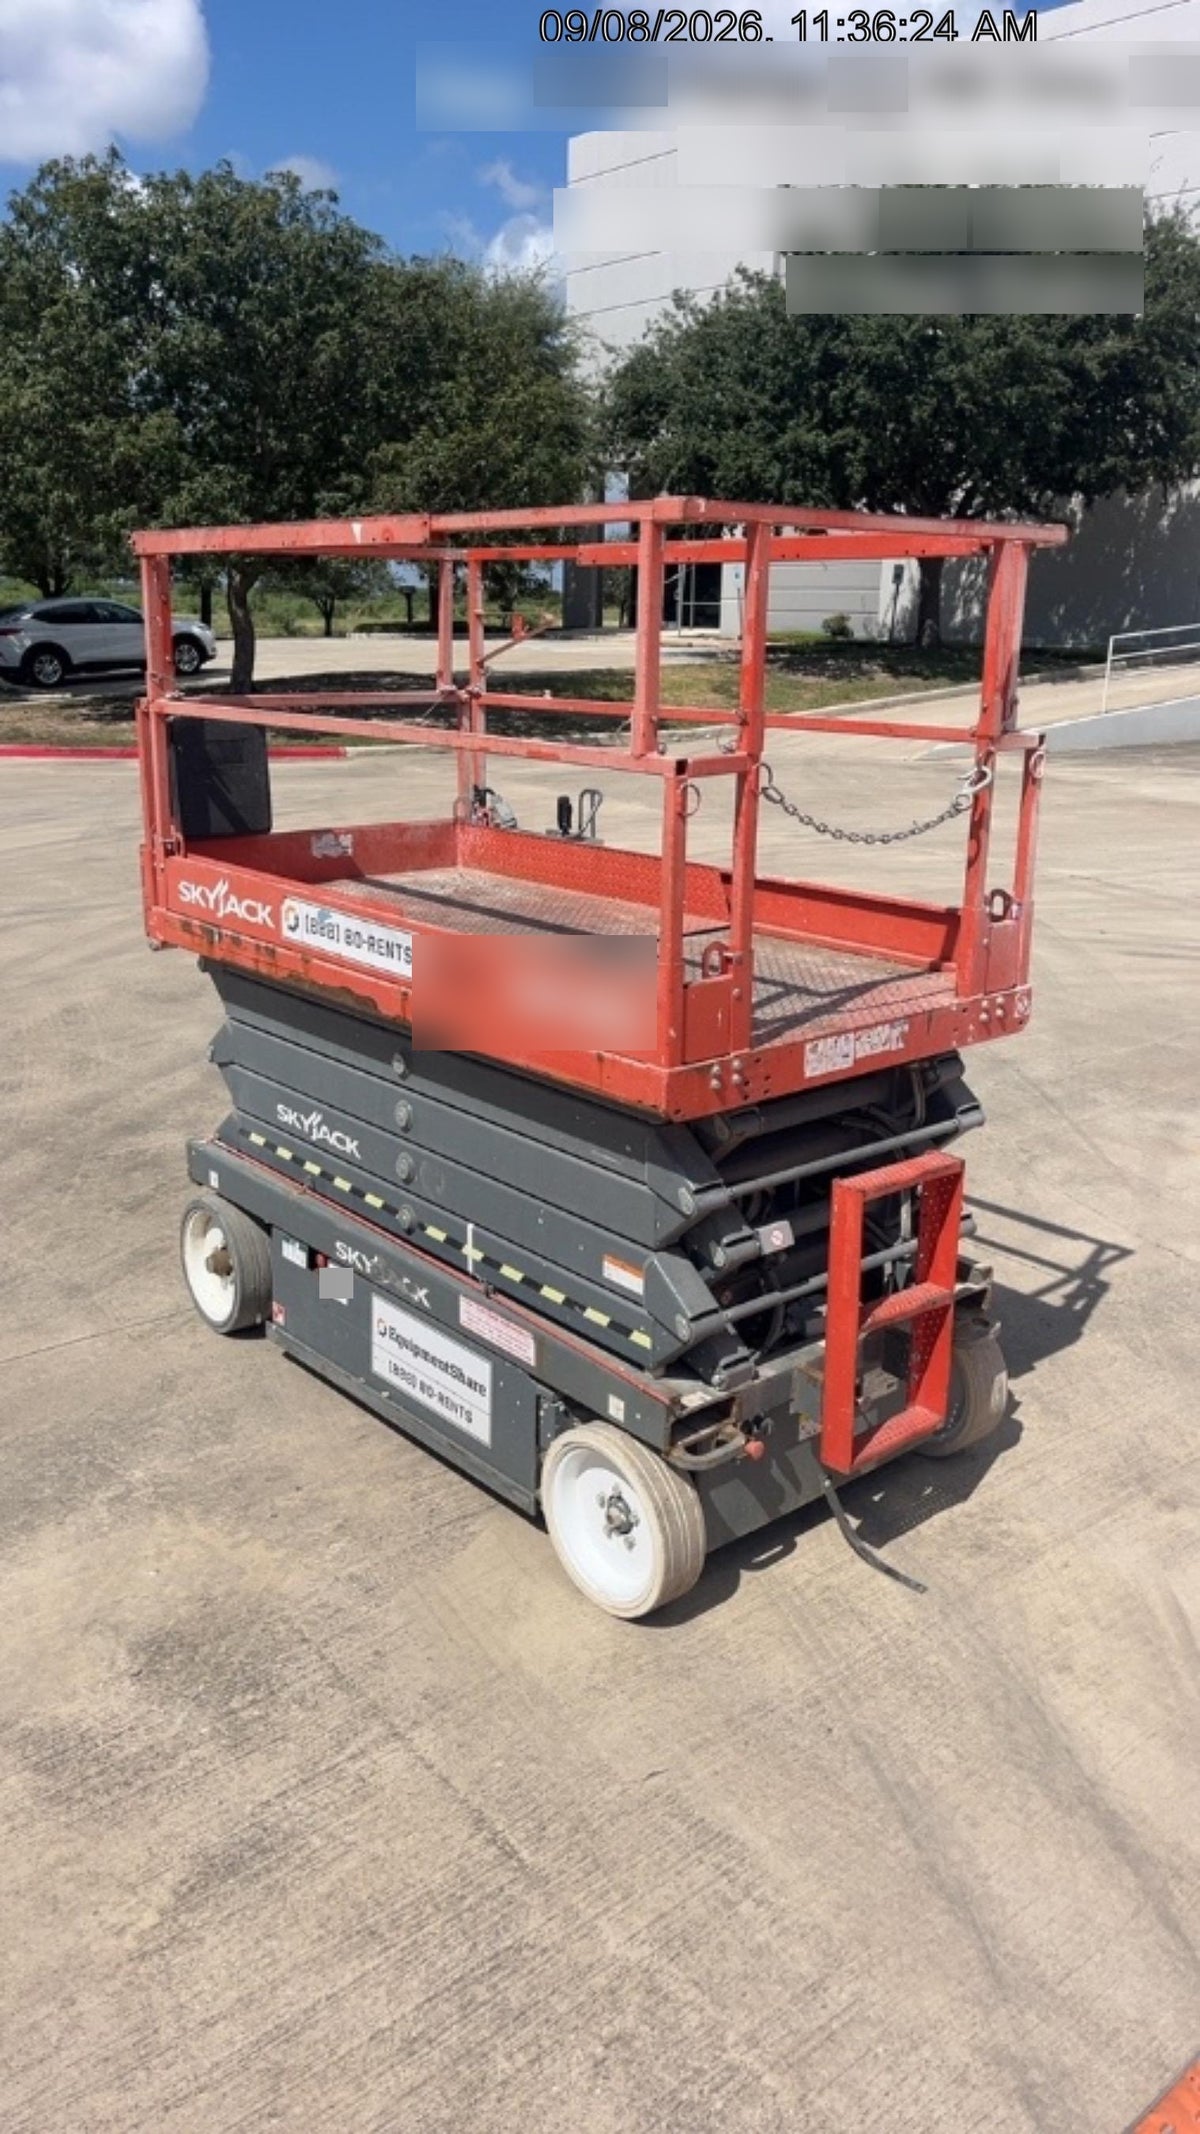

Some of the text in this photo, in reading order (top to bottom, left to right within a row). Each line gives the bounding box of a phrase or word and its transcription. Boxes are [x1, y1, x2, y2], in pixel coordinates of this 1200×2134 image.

[178, 878, 275, 928] SKYJACK
[344, 928, 413, 965] 80-RENTS
[276, 1103, 361, 1159] SKYJACK
[388, 1325, 487, 1397] EquipmentShare
